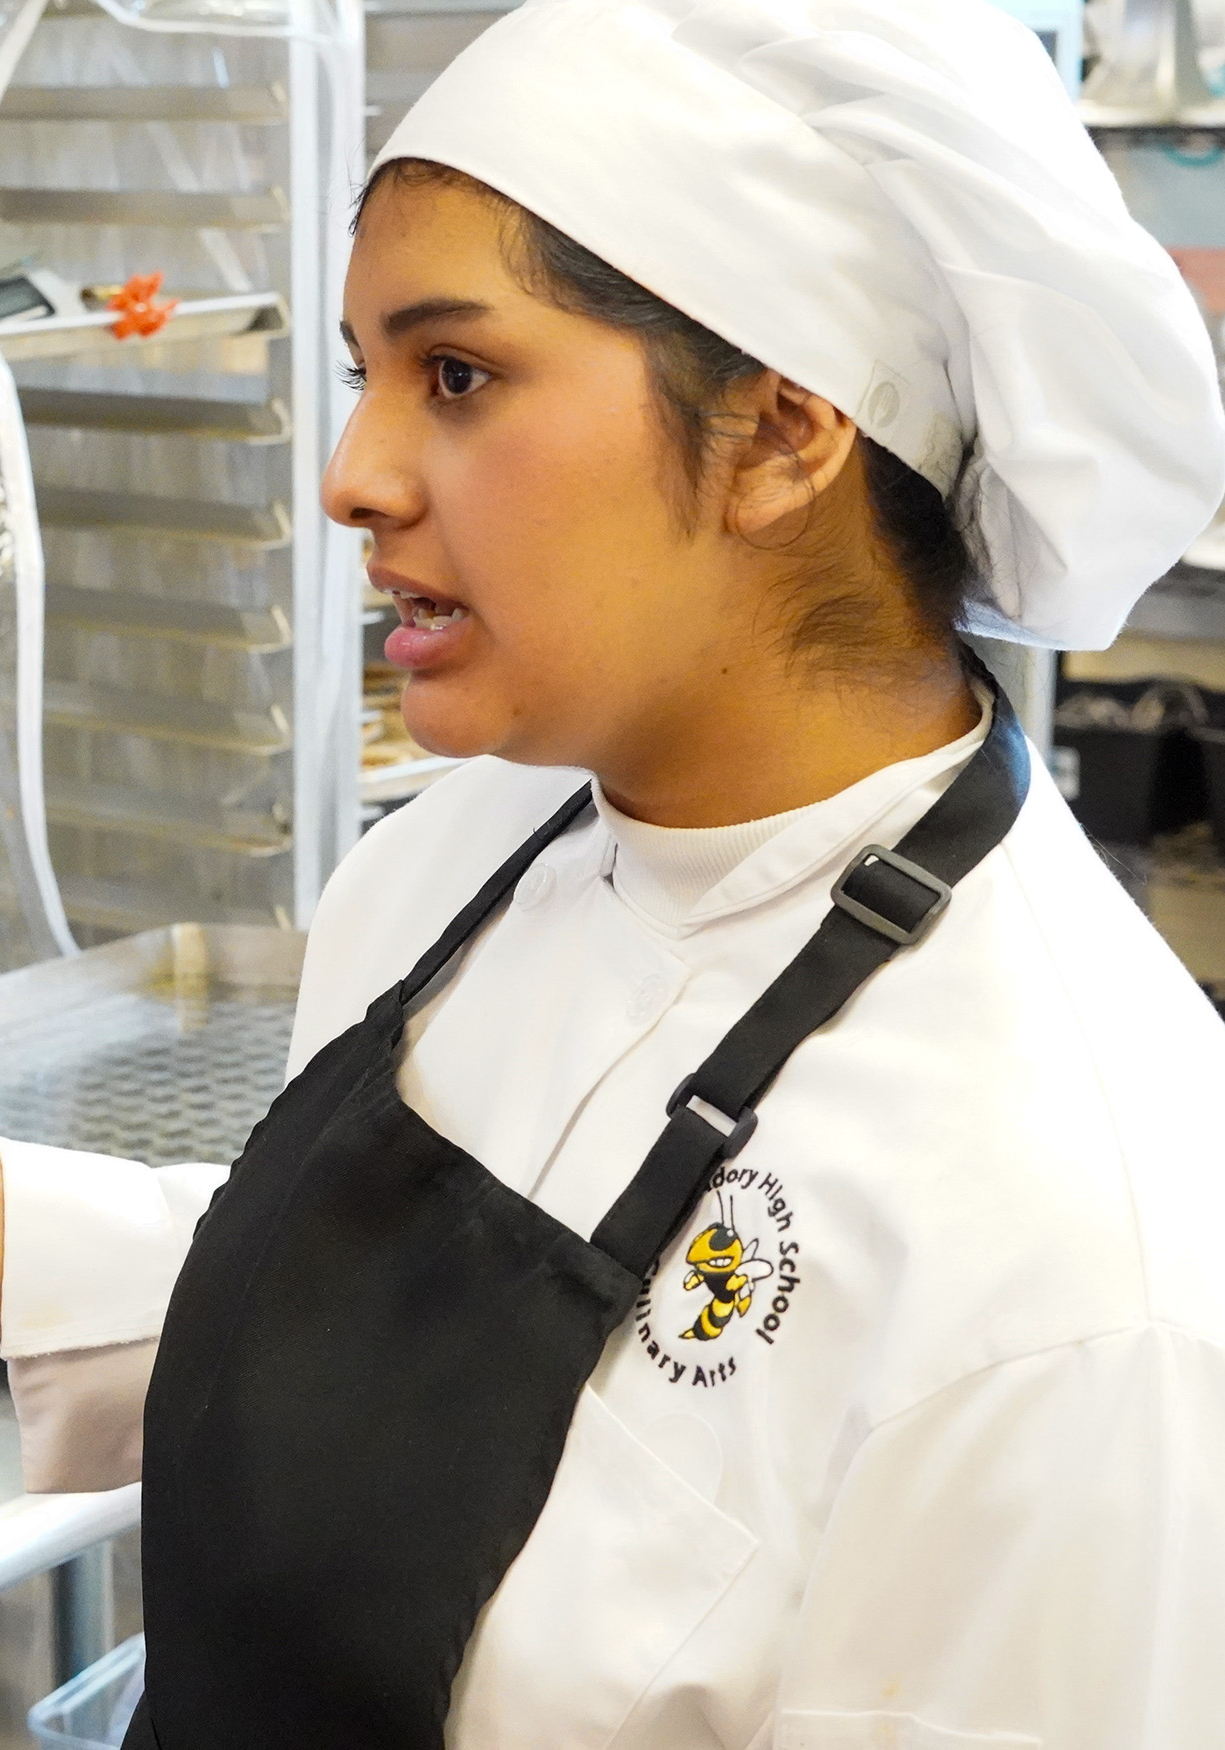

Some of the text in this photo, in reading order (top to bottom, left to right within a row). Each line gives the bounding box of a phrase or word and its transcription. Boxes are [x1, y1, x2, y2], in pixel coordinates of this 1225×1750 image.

[636, 1258, 737, 1388] ulinary Arts
[707, 1166, 801, 1345] dory High School
